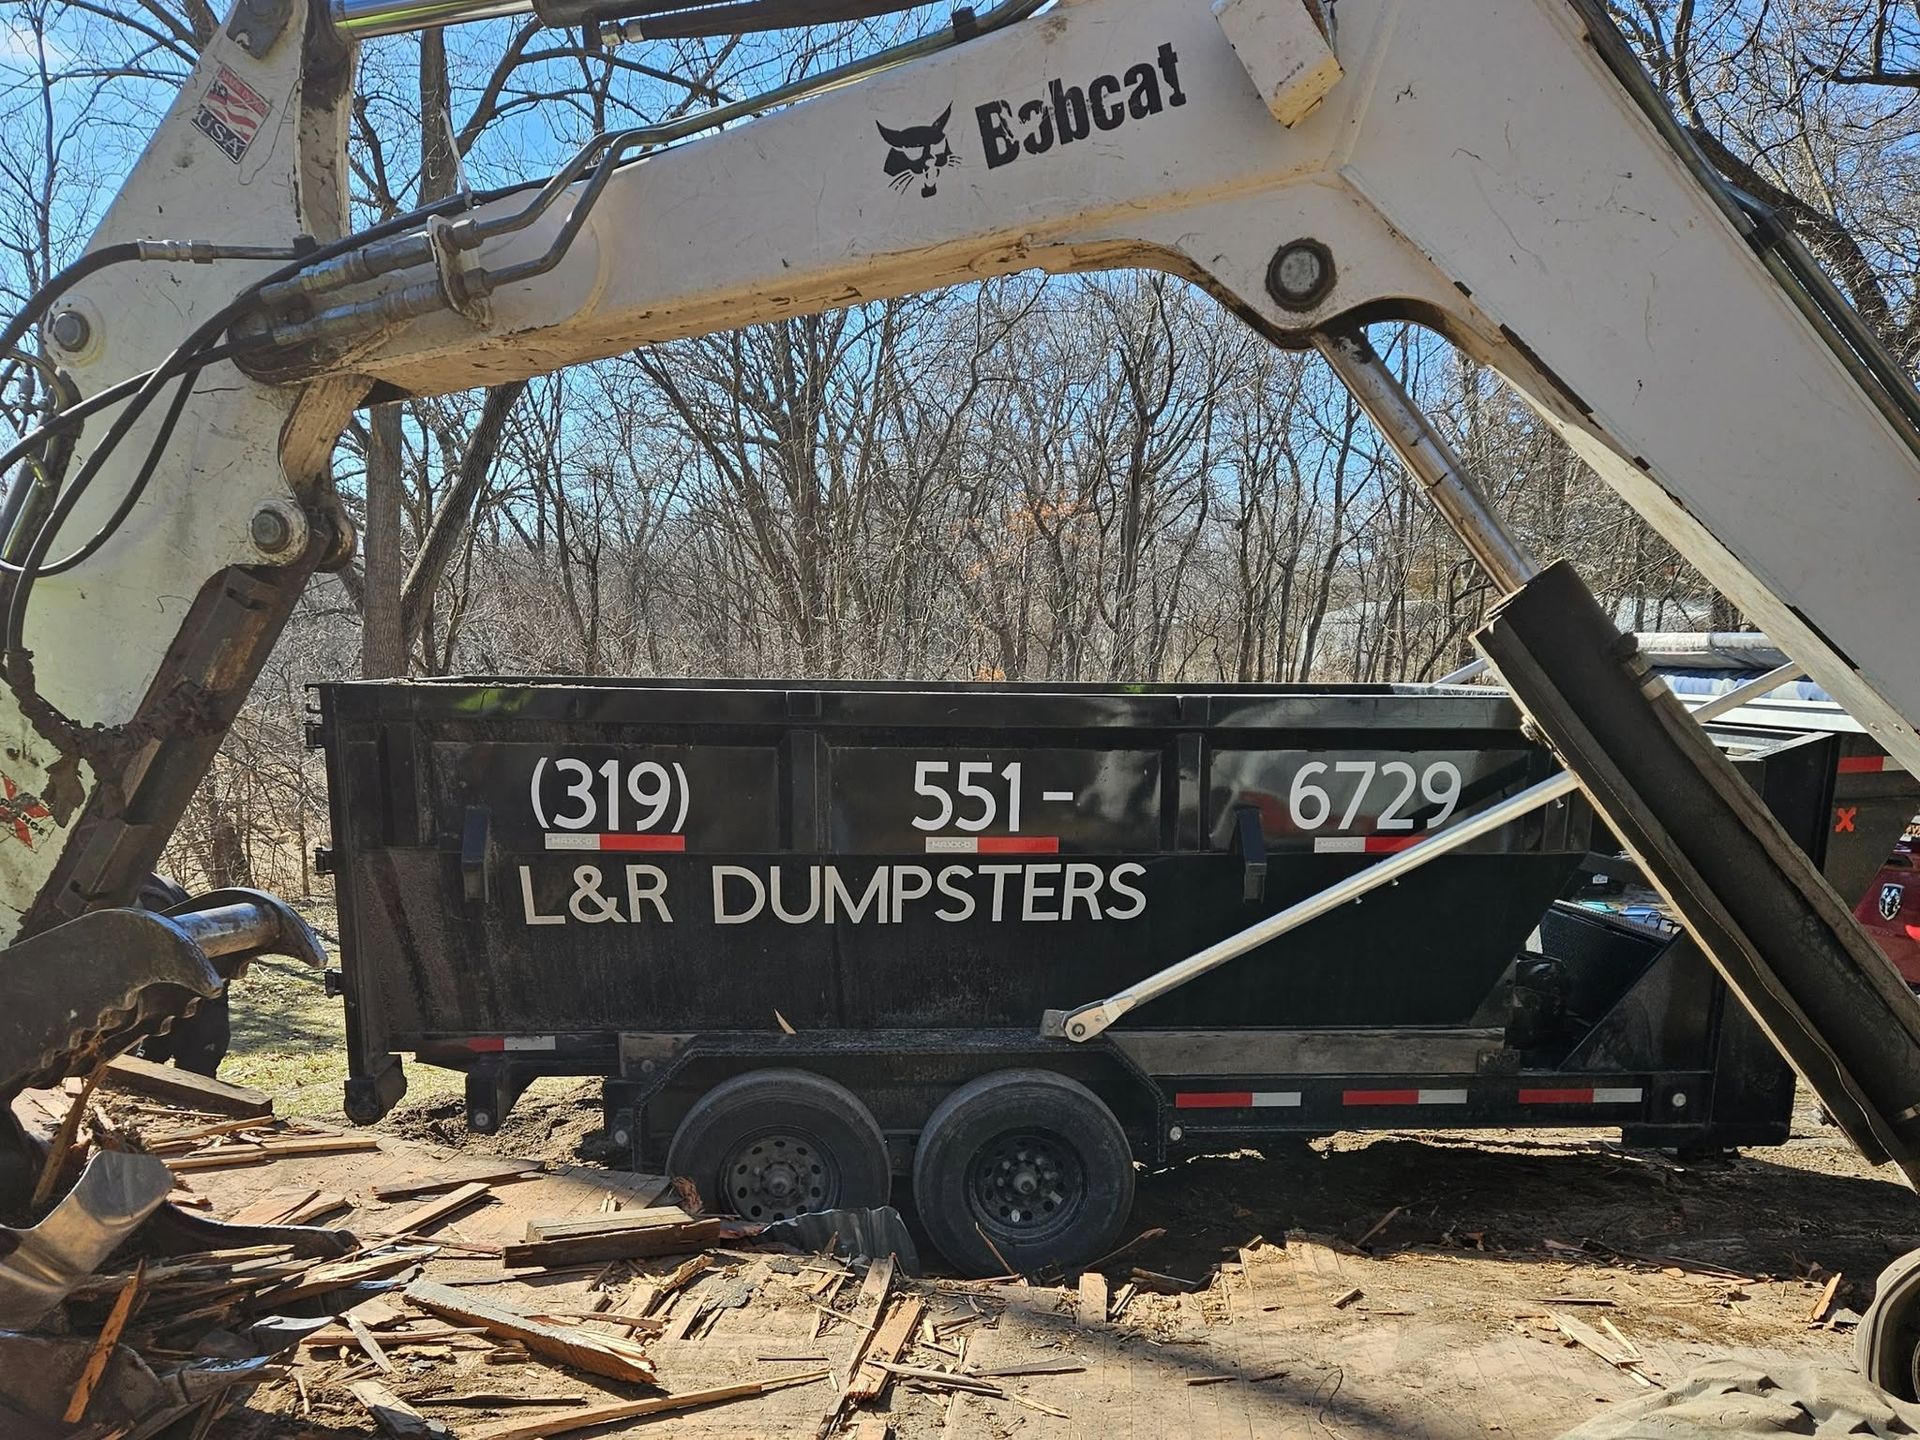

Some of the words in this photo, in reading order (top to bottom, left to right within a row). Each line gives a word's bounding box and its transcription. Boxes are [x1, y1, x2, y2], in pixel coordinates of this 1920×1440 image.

[197, 109, 242, 155] USA
[975, 42, 1187, 169] Bobcat
[531, 758, 689, 832] (319)
[1290, 762, 1461, 829] 6729
[520, 865, 673, 924] L&R
[713, 863, 1146, 923] DUMPSTERS
